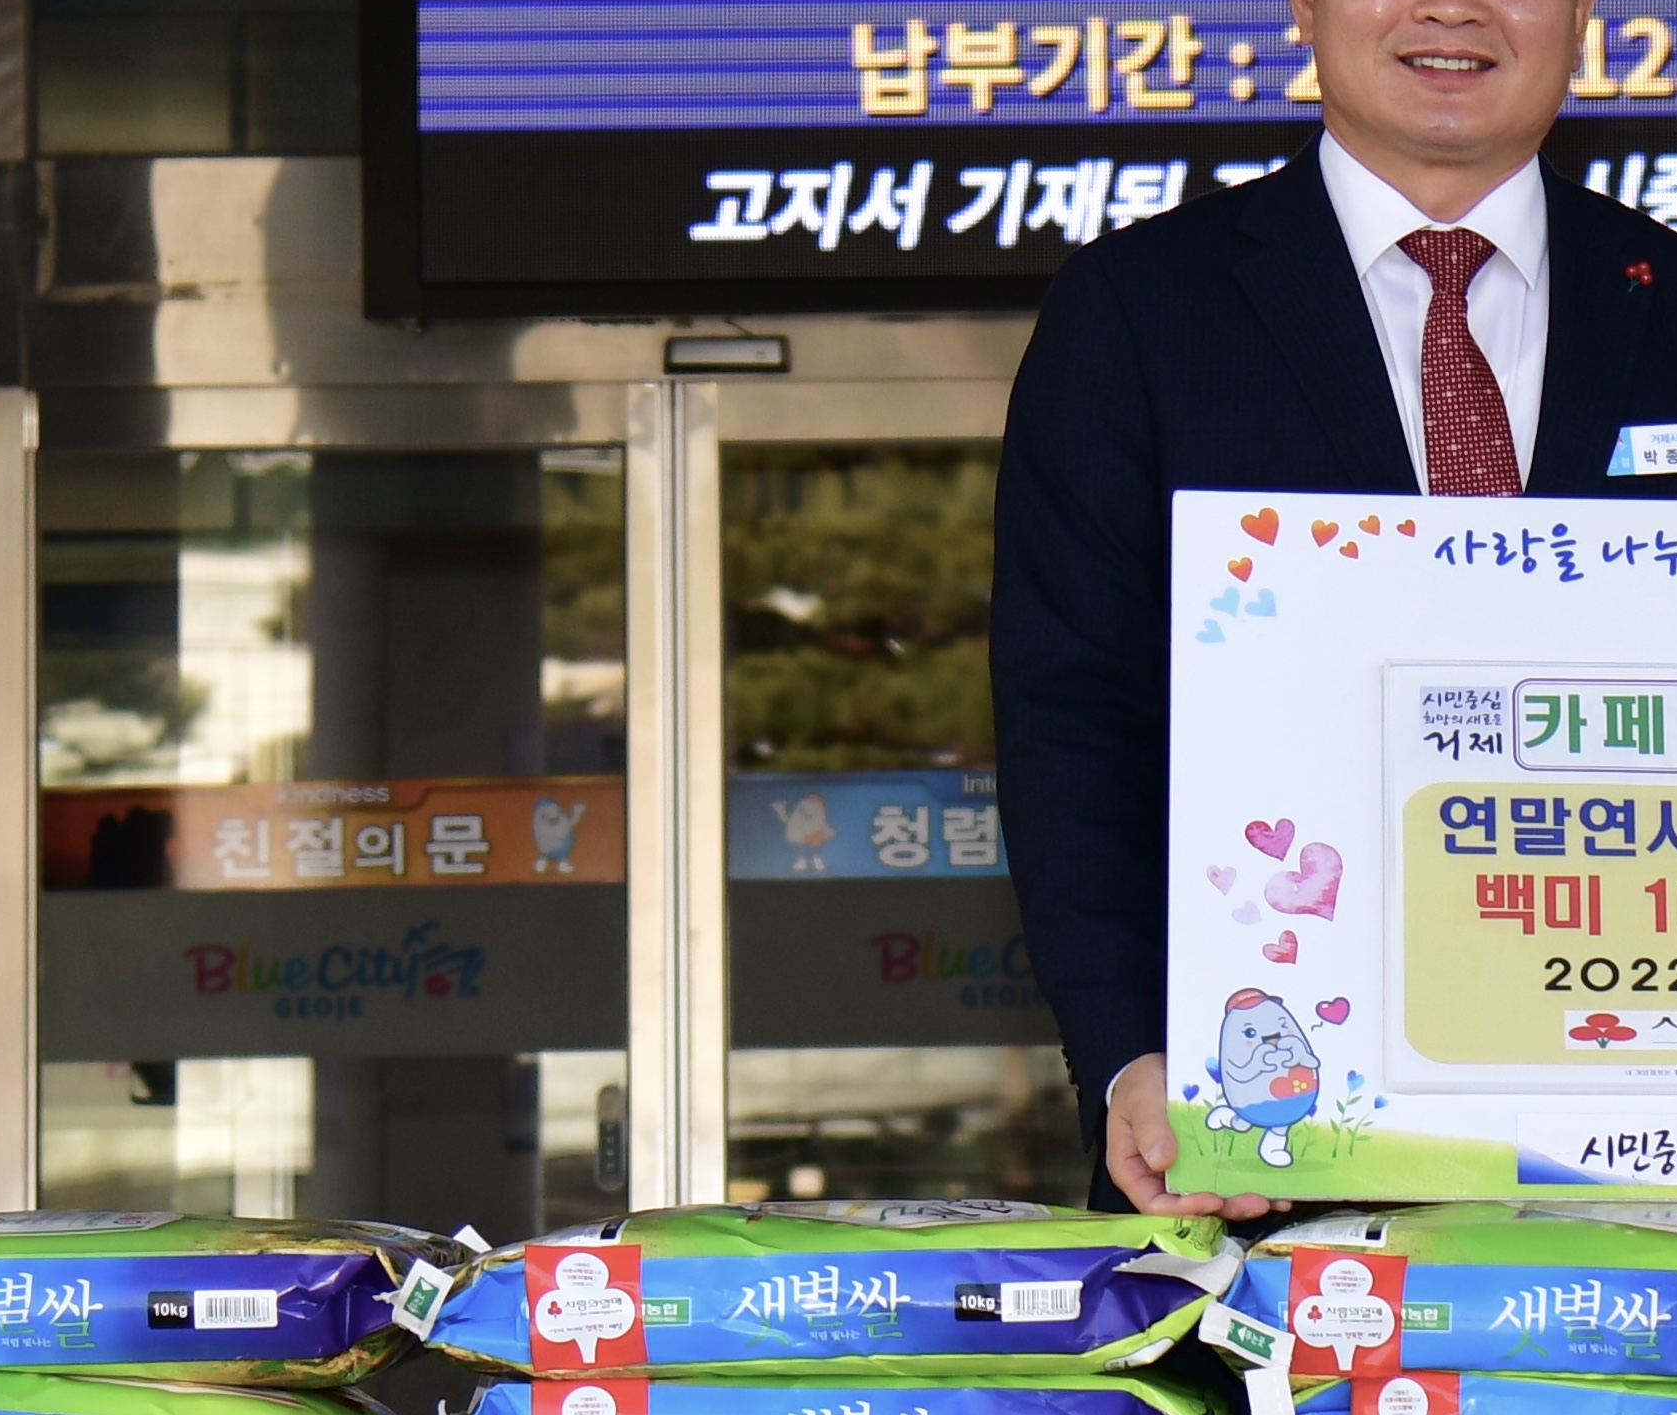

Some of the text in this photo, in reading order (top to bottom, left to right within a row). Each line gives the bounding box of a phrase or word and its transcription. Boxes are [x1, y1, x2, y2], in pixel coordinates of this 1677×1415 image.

[850, 15, 1207, 117] 납부기간
[687, 159, 935, 252] 고지서
[1435, 523, 1584, 582] 사랑을
[1423, 690, 1502, 710] 시민중심
[1423, 711, 1502, 726] 희망의 새로운
[1523, 694, 1665, 755] 카페
[213, 814, 490, 879] 친절의 문
[1476, 874, 1601, 935] 백미
[152, 1300, 188, 1319] 10kg
[960, 1294, 995, 1312] 10kg
